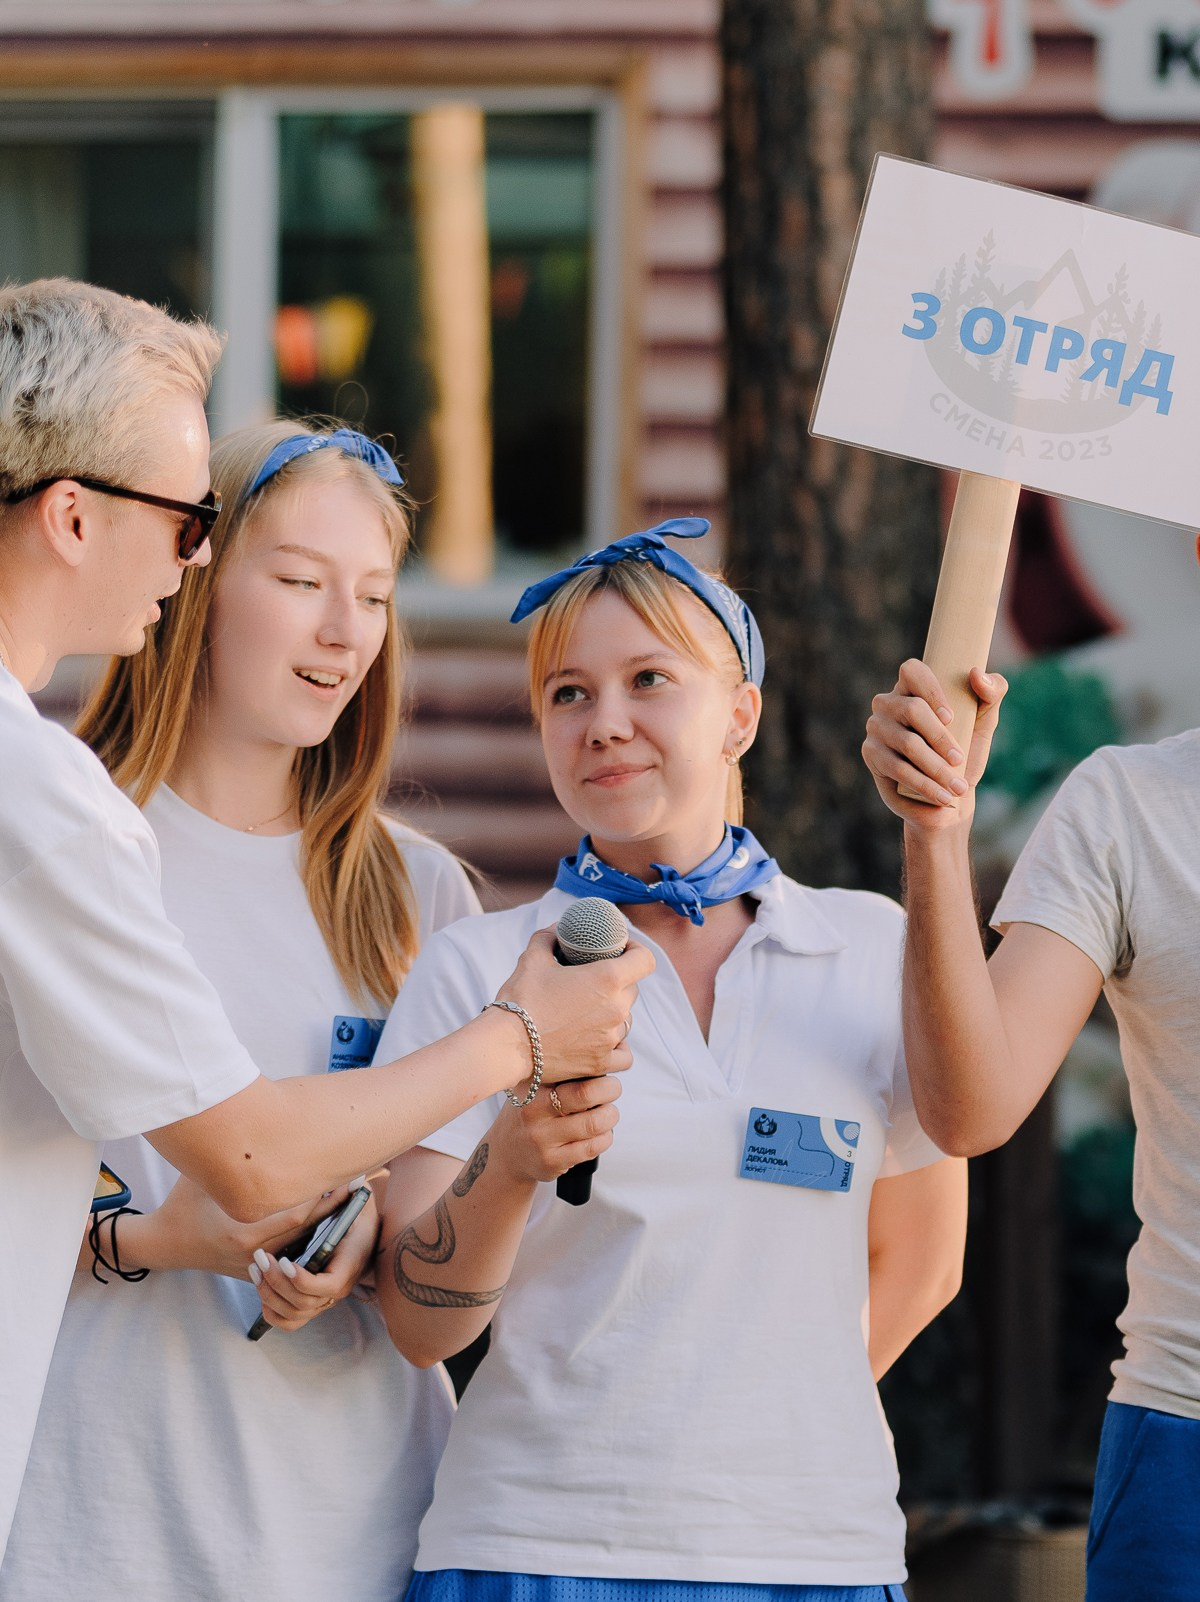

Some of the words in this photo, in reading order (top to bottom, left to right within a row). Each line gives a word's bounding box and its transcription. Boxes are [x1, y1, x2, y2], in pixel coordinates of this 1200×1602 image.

[959, 306, 1176, 416] ОТРЯД
[929, 392, 1026, 458] СМЕНА
[1038, 435, 1114, 462] 2023
[748, 1145, 776, 1154] ЛИДИЯ
[847, 1150, 852, 1158] 3
[746, 1155, 788, 1166] ДЕКАЛОВА
[840, 1162, 850, 1187] ОТРЯД
